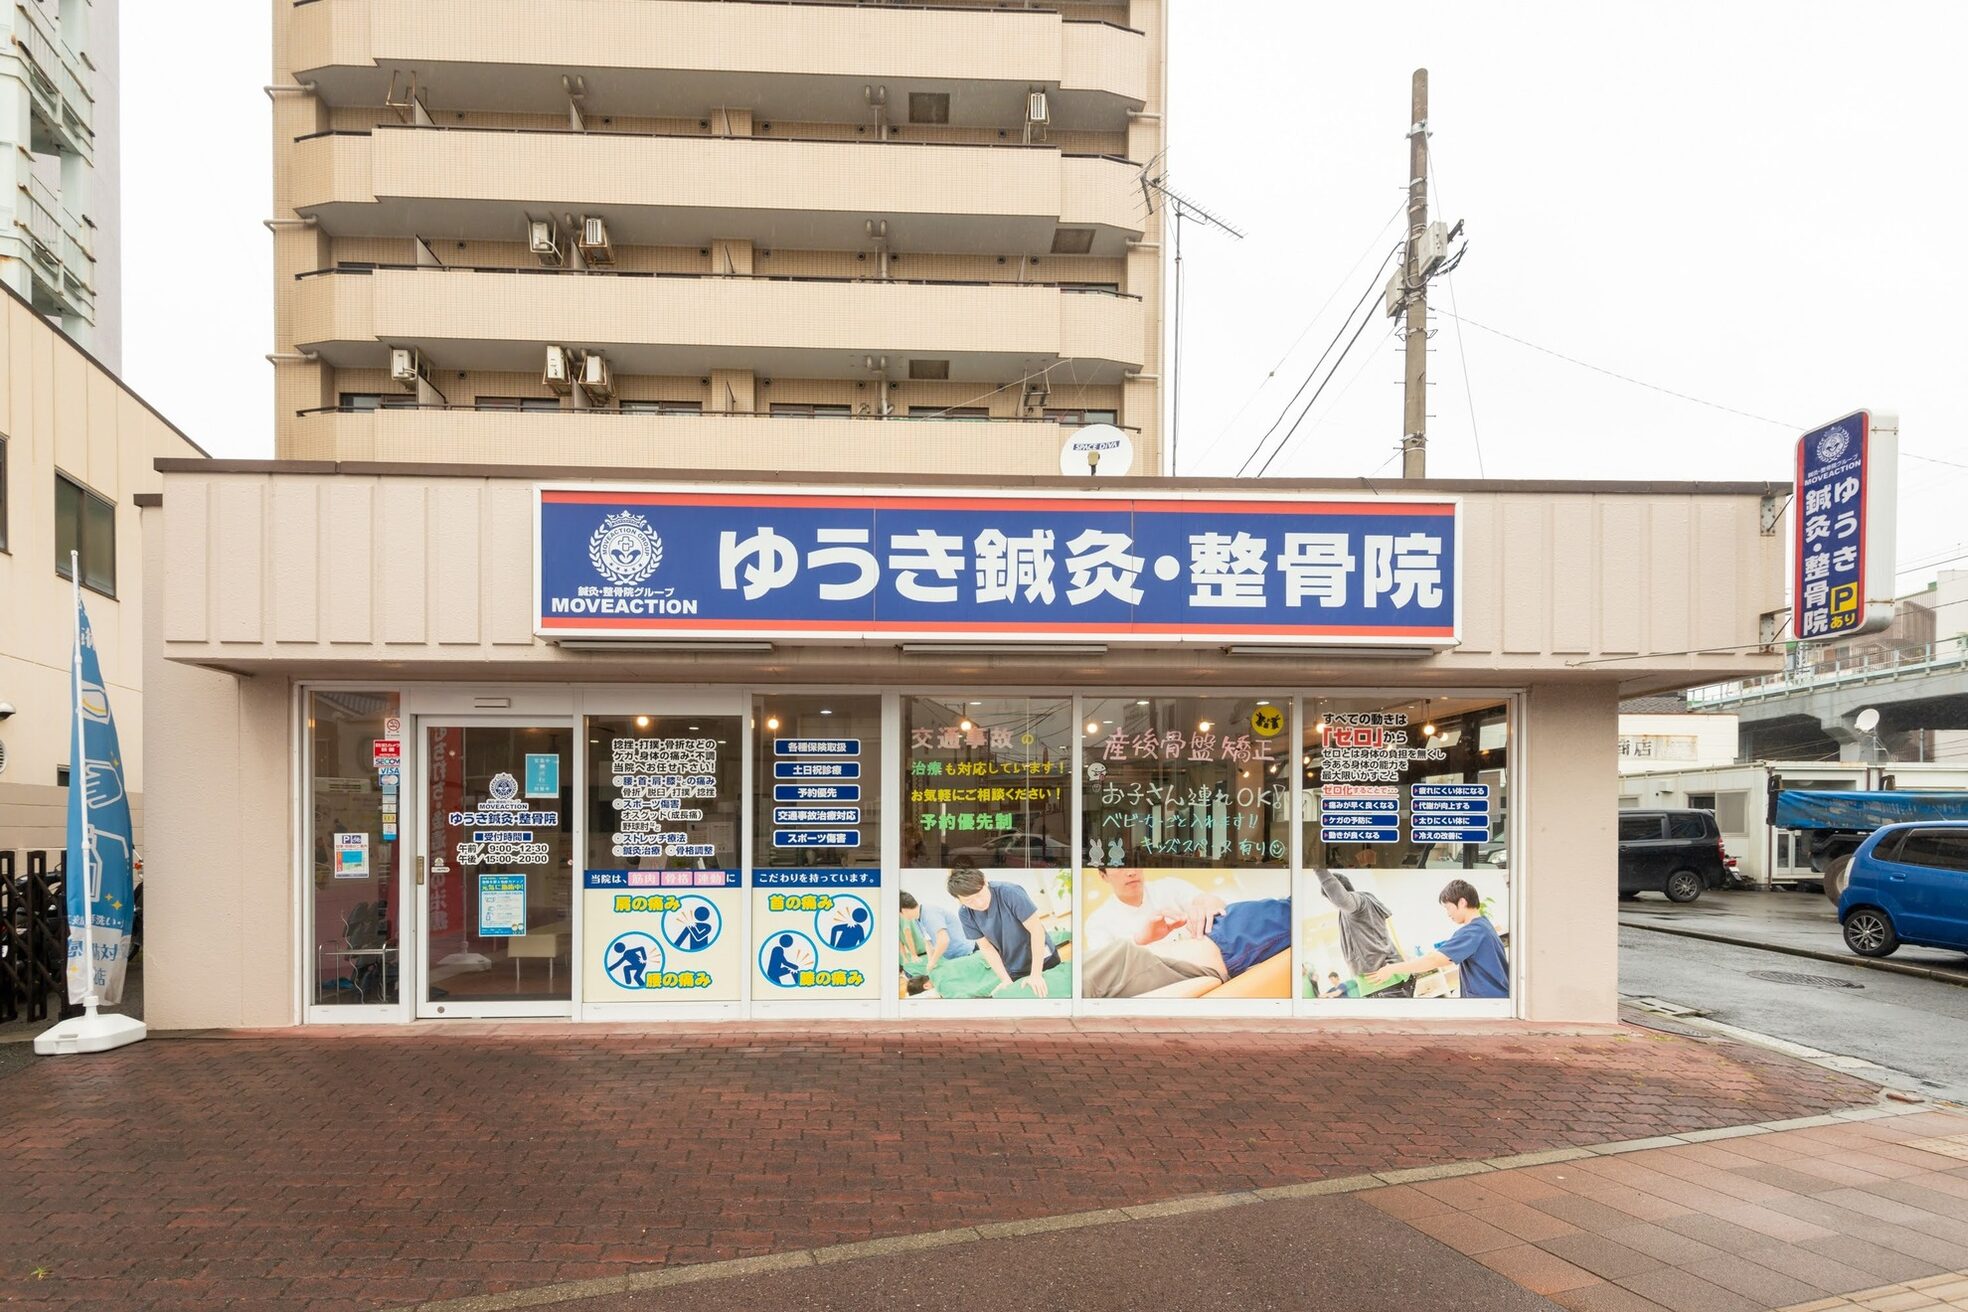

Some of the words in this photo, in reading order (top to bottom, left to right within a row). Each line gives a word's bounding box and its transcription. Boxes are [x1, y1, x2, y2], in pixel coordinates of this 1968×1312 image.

[1804, 459, 1862, 487] MOVEACTION
[1832, 476, 1860, 573] ゆうき
[602, 527, 638, 556] MOVEACTION
[637, 533, 650, 557] GROUP
[1803, 484, 1832, 637] 鍼灸・整骨院
[718, 527, 1443, 609] ゆうき鍼灸・整骨院
[577, 586, 675, 597] 鍼灸・整骨院グループ
[1835, 584, 1854, 612] P
[551, 597, 698, 614] MOVEACTION
[1830, 612, 1856, 629] あり
[1323, 713, 1407, 725] すべての動きは
[1102, 727, 1275, 763] 産後骨盤矯正
[613, 751, 715, 761] ケガ、身体の痛み・不調
[1322, 750, 1446, 759] ゼロとは身体の負担を無くし
[1322, 760, 1408, 769] 今ある身体の能力を
[793, 765, 842, 775] 土日祝診療
[1322, 771, 1398, 781] 最大限いかすこと
[798, 788, 837, 798] 予約優先
[1418, 787, 1485, 795] 疲れにくい体になる
[623, 800, 680, 809] スポーツ傷害
[1328, 801, 1395, 809] 痛みが早く良くなる
[450, 813, 557, 825] ゆうき鍼灸・整骨院
[778, 811, 857, 820] 交通事故治療対応
[1328, 816, 1373, 825] ケガの予防に
[920, 813, 1013, 831] 予約優先制
[1418, 817, 1470, 825] 太りにくい体に
[623, 833, 686, 843] ストレッチ療法
[788, 833, 847, 843] スポーツ傷害
[1328, 831, 1380, 840] 動きが良くなる
[1418, 832, 1463, 840] 冷えの改善に
[623, 846, 661, 855] 鍼灸治療
[675, 846, 714, 855] 骨格調整
[759, 873, 874, 883] こだわりを持っています。
